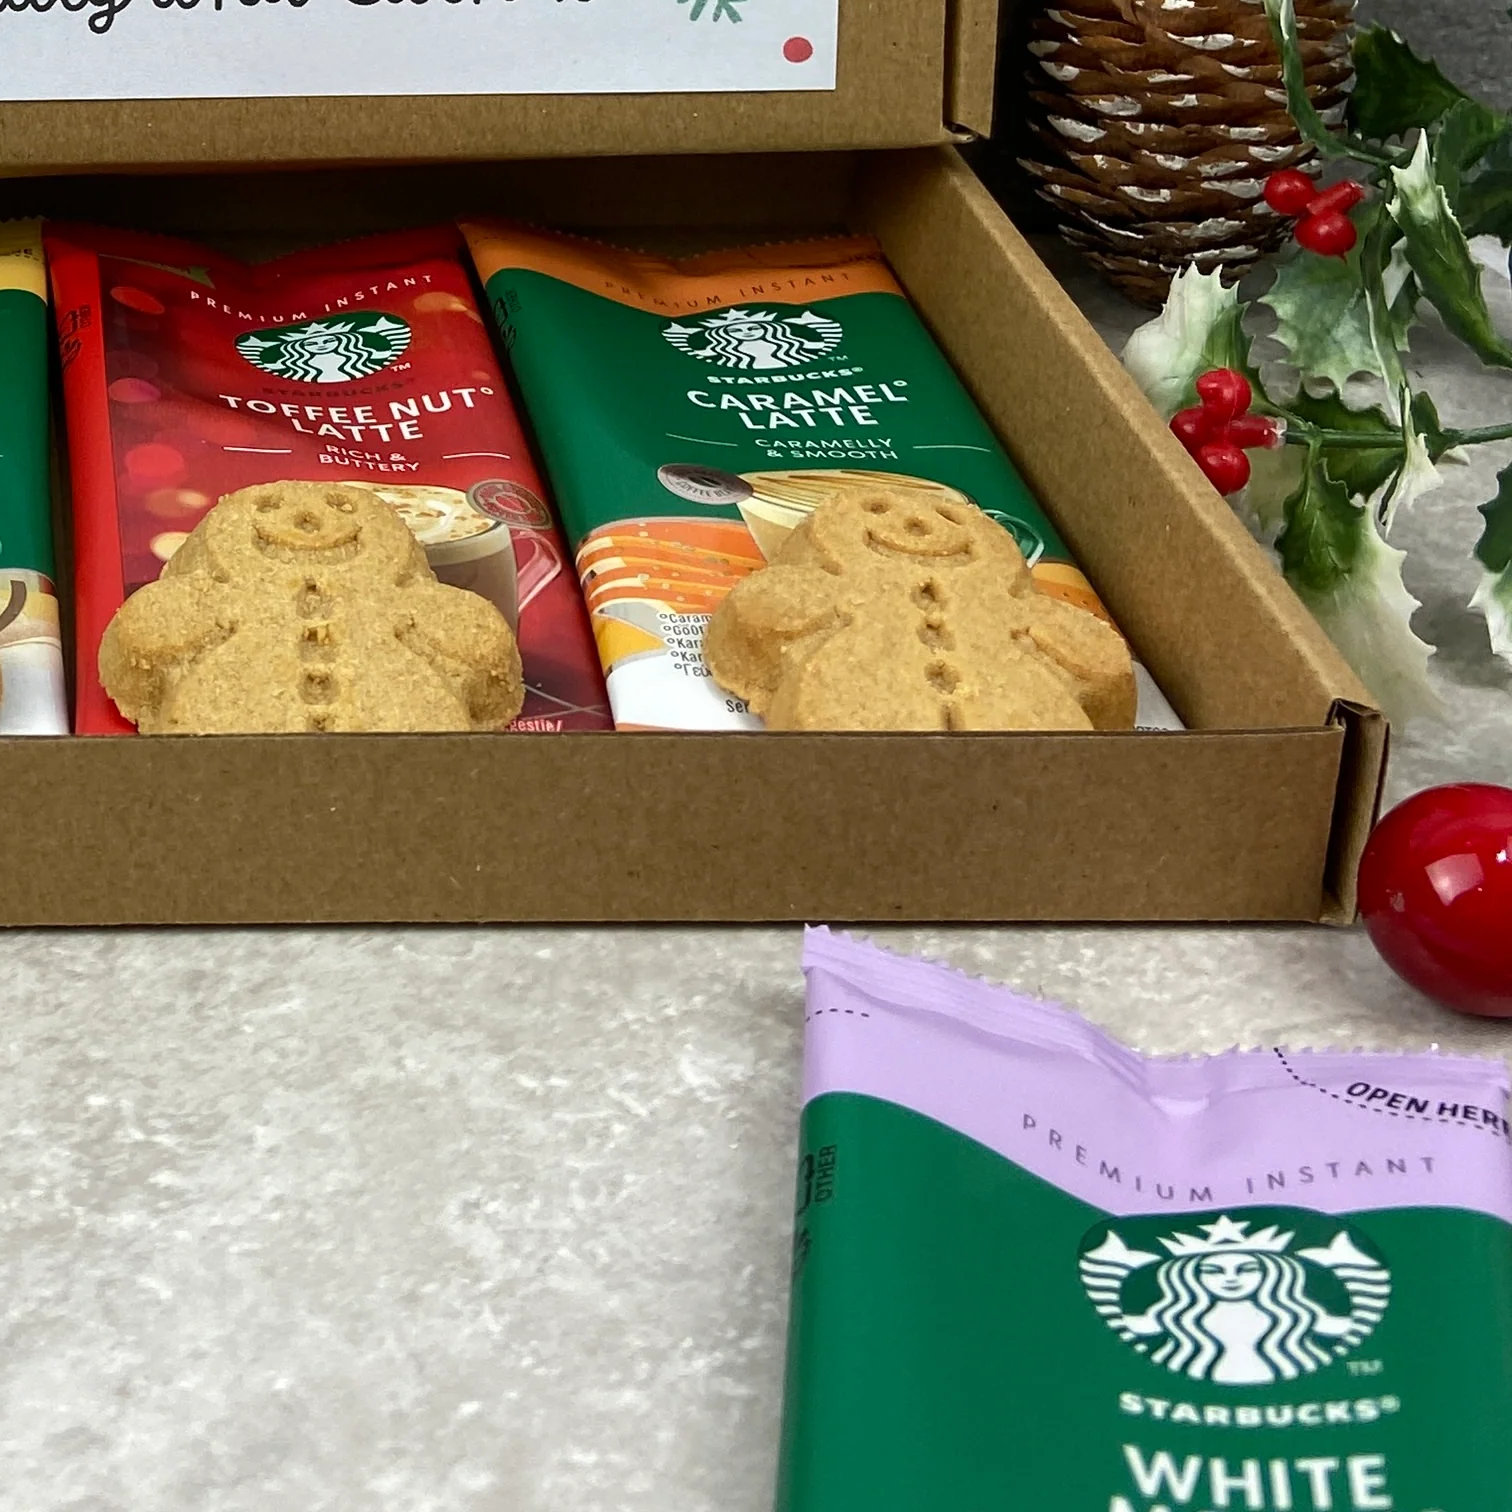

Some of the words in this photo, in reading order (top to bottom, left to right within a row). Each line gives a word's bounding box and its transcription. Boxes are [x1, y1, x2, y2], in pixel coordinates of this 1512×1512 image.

[739, 273, 850, 297] INSTANT
[191, 290, 307, 323] PREMIUM
[324, 275, 433, 312] INSTANT
[219, 394, 375, 424] TOFFEE
[738, 404, 879, 430] LATTE
[291, 417, 423, 443] LATTE
[325, 444, 381, 462] RICH
[389, 452, 407, 462] &
[754, 437, 892, 450] CARAMELLY
[790, 449, 899, 460] SMOOTH
[320, 454, 420, 473] BUTTERY
[1346, 1081, 1430, 1113] OPEN
[1022, 1111, 1216, 1204] PREMIUM
[1245, 1155, 1437, 1195] INSTANT
[1121, 1443, 1394, 1512] WHITE
